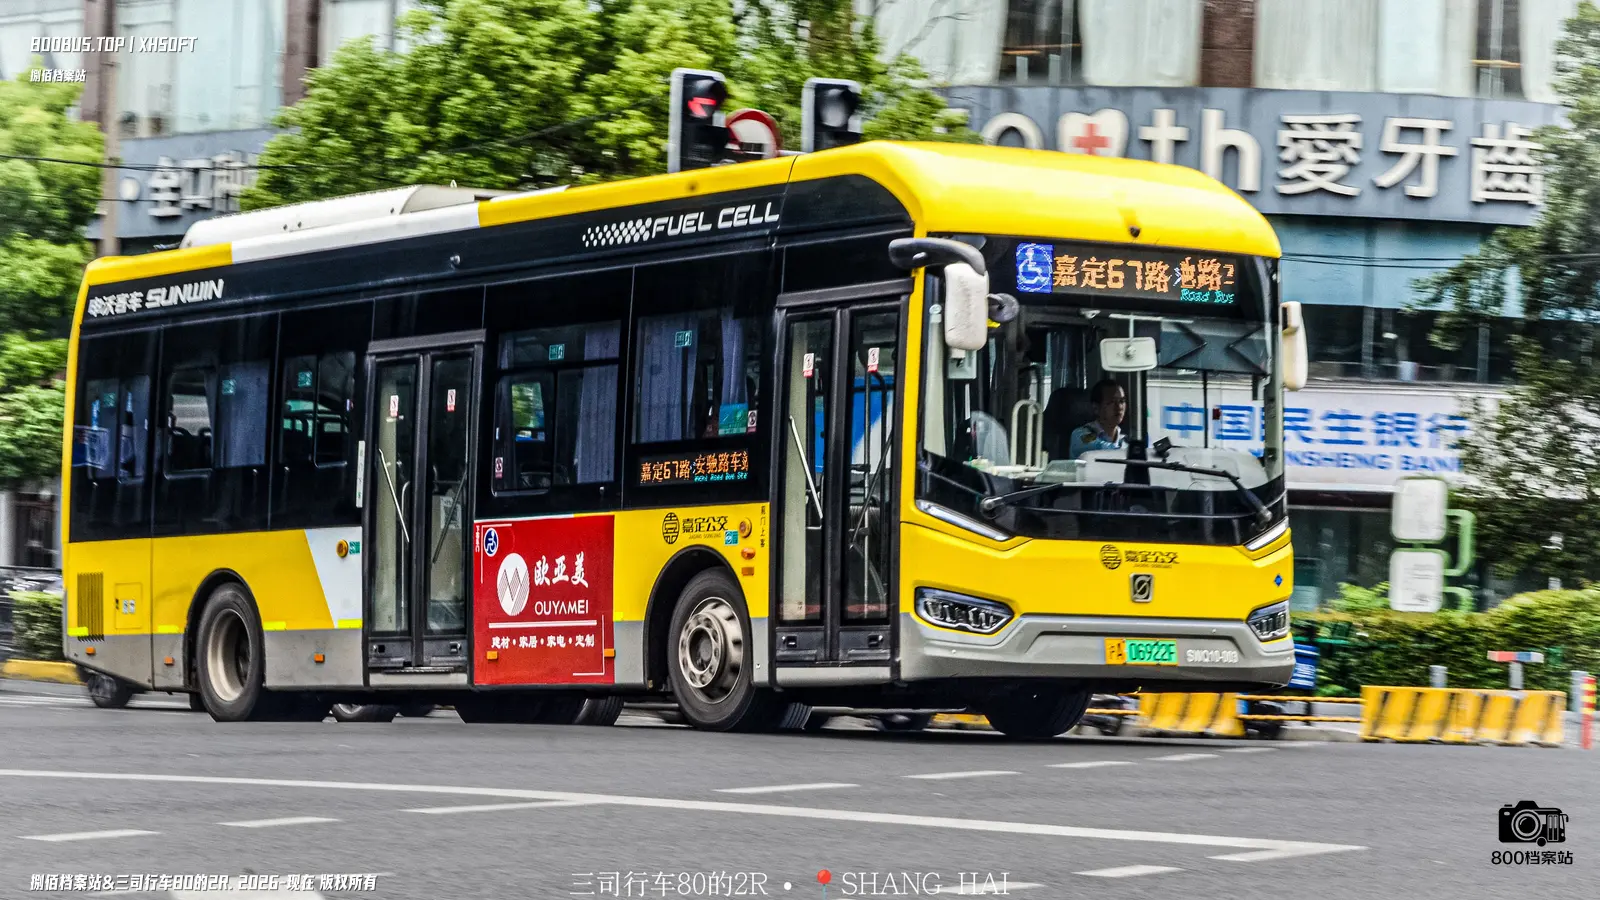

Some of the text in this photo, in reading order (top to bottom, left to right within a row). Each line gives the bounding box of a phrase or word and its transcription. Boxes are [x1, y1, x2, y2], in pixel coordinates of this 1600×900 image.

[1274, 113, 1546, 206] 愛牙齒
[651, 201, 780, 239] FUEL CELL
[1053, 254, 1170, 293] 嘉定67路
[145, 278, 225, 309] SUNWIN
[1180, 287, 1211, 303] Road
[640, 459, 691, 483] 嘉定67路
[682, 515, 729, 533] 嘉定公交
[534, 551, 589, 588] 欧亚美
[534, 599, 589, 616] OUYAMEI
